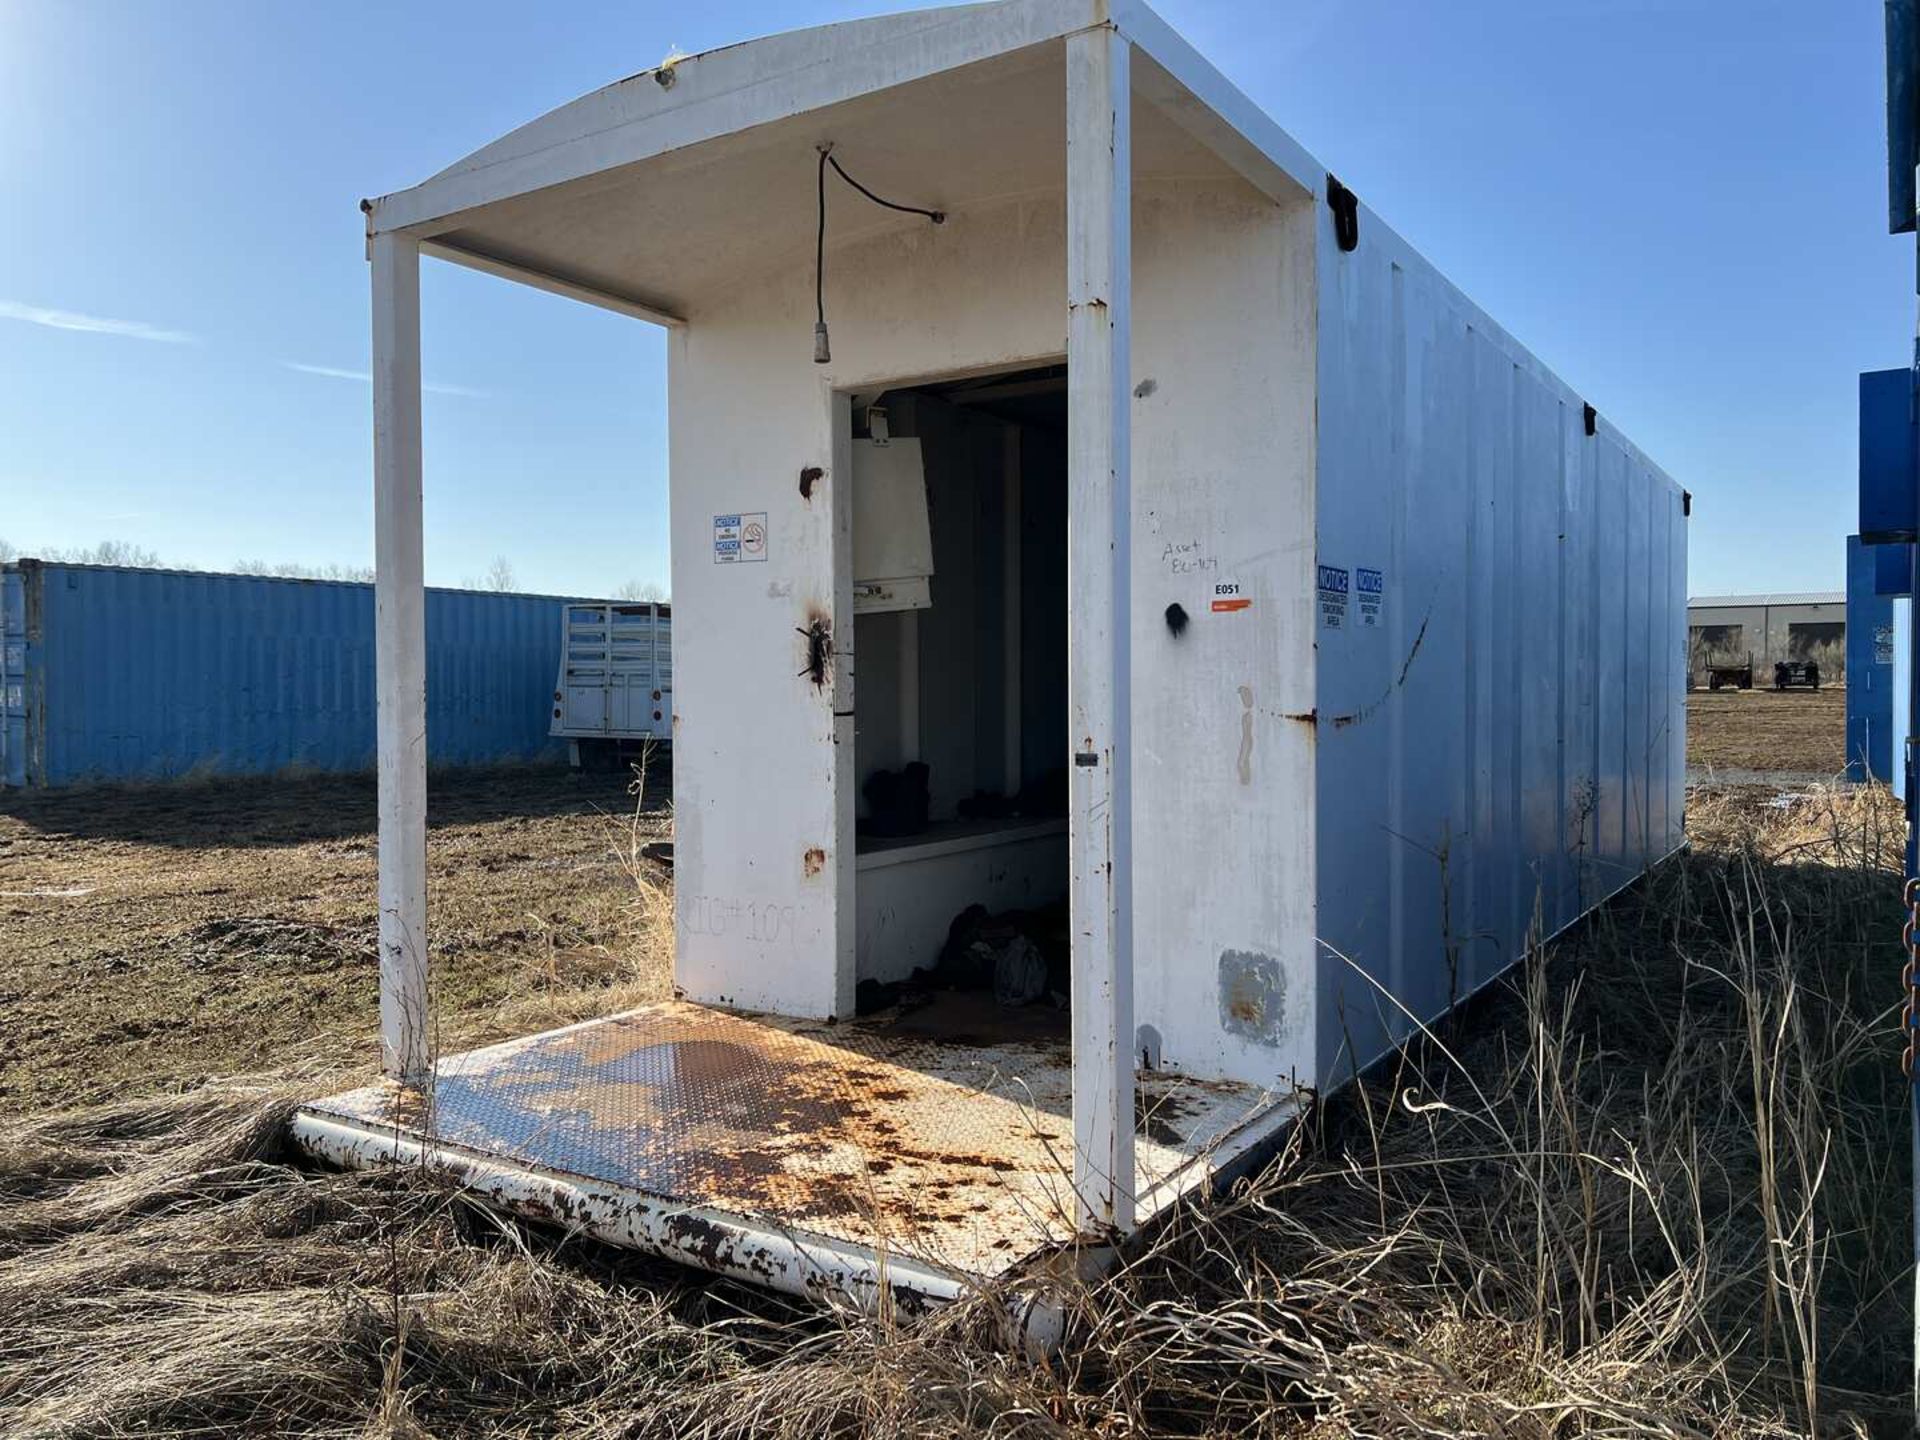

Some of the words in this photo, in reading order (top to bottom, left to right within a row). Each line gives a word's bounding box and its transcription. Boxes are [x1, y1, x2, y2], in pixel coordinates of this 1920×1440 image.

[1215, 584, 1239, 595] E051
[1319, 567, 1348, 592] NOTICE
[1357, 569, 1381, 592] NOTICE
